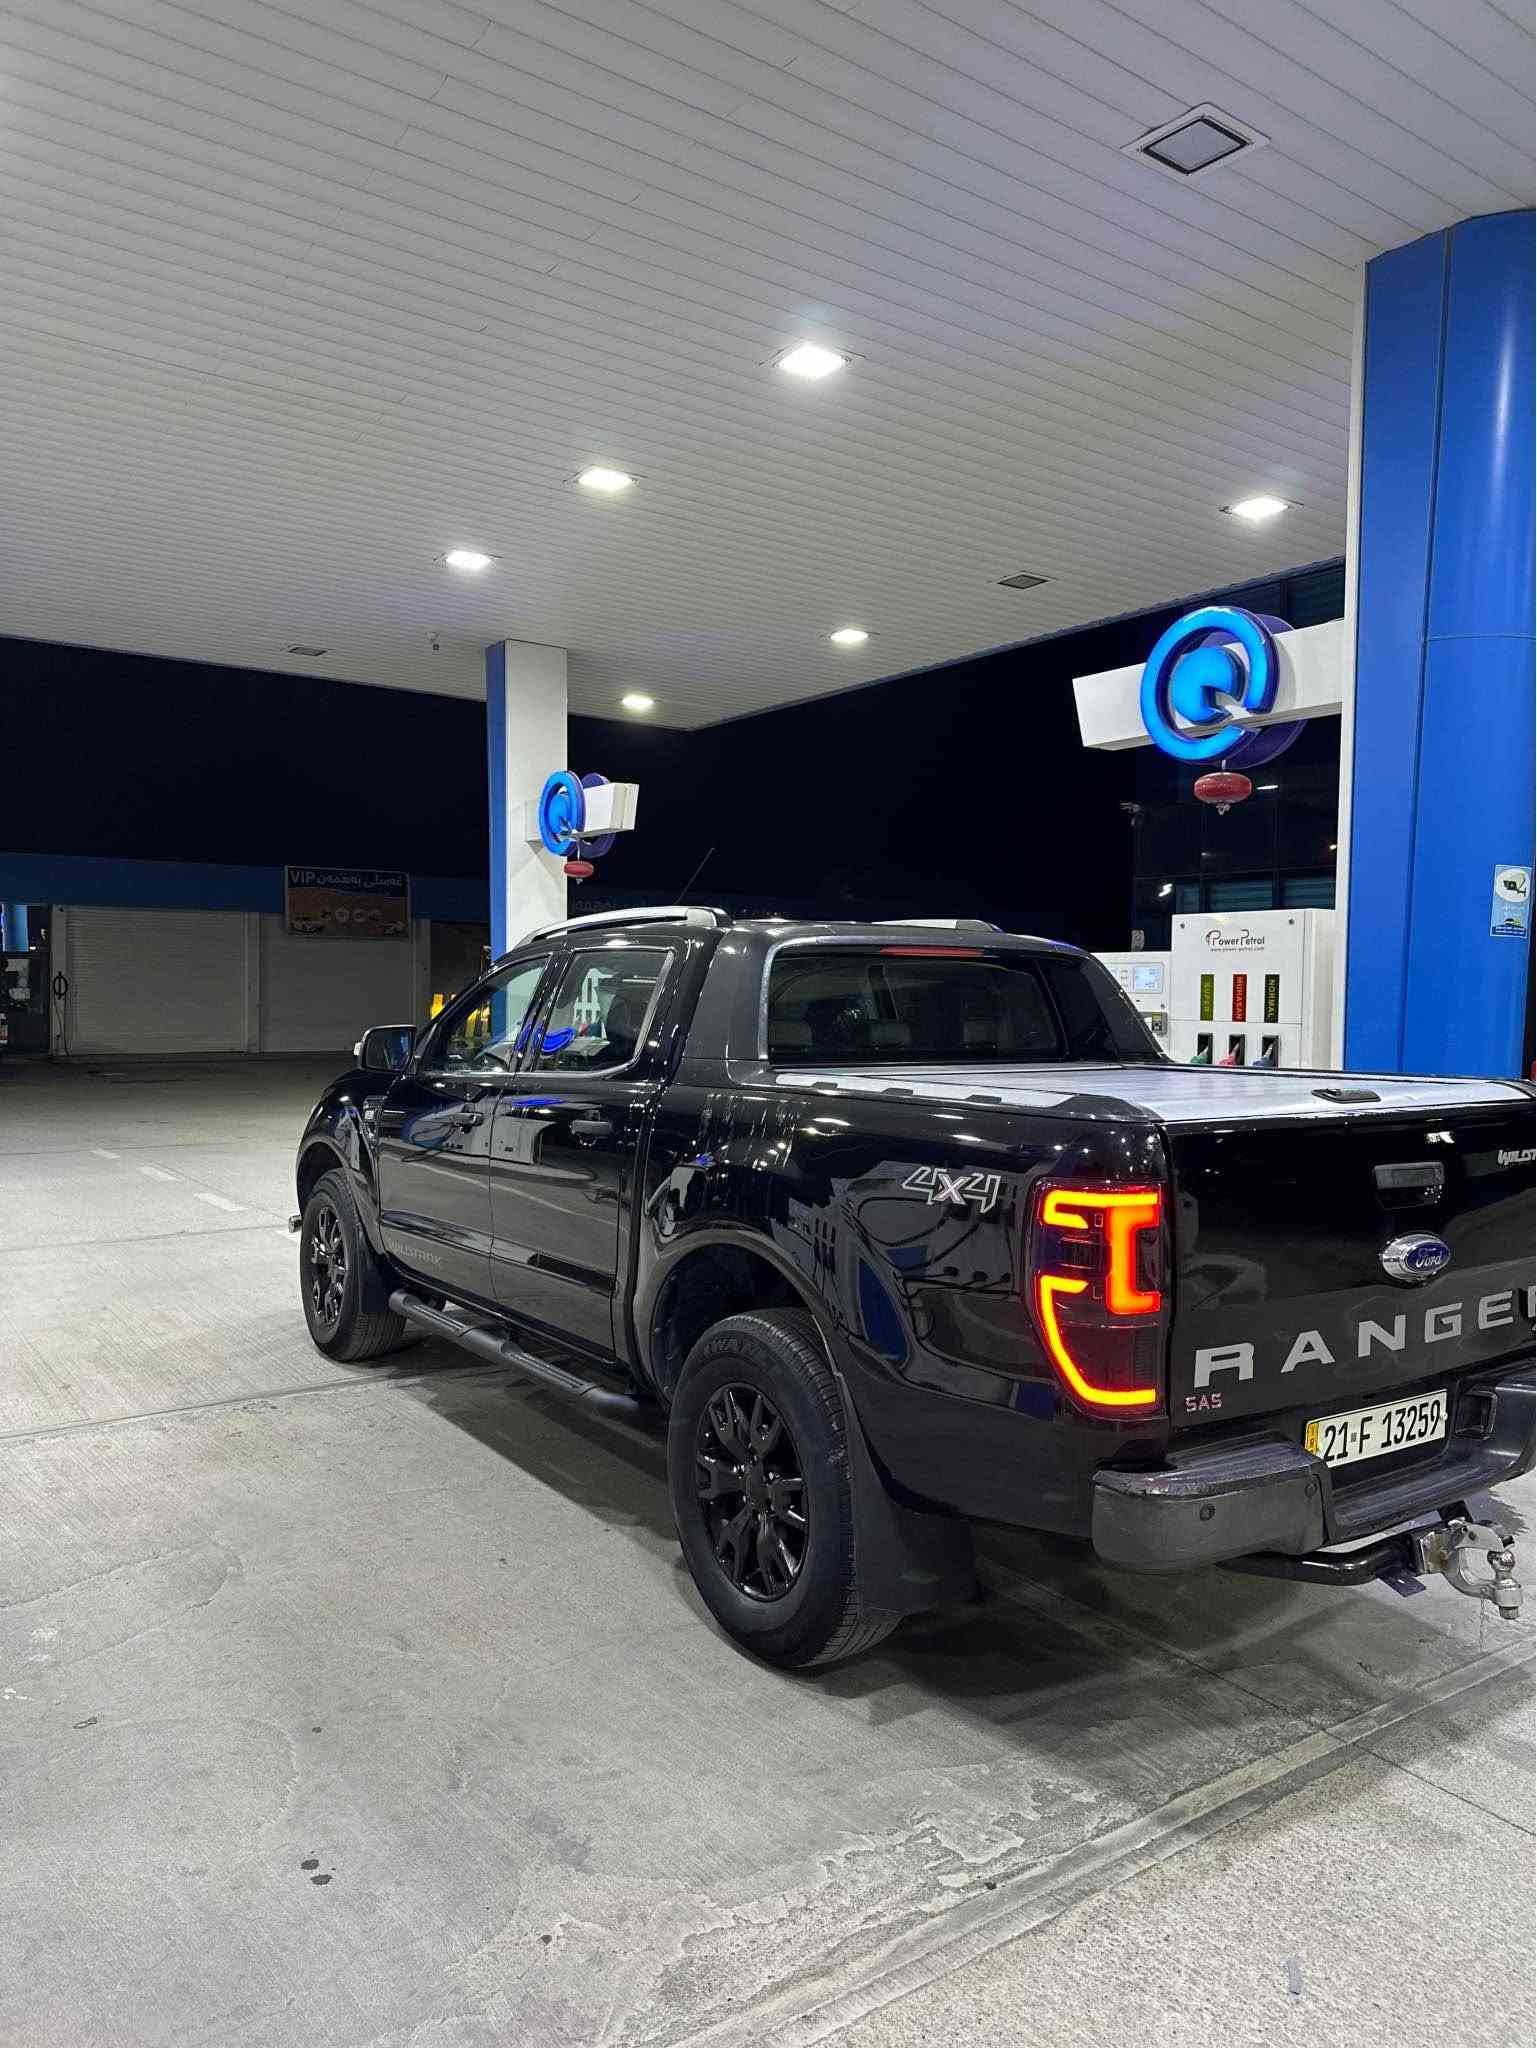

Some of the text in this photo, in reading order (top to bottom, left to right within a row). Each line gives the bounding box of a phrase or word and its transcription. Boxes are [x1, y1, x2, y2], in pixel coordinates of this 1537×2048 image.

[289, 871, 316, 884] VIP
[1268, 979, 1276, 1018] NORMAL
[1415, 1248, 1442, 1268] Ford
[1194, 1286, 1535, 1388] RANGE
[1186, 1392, 1222, 1412] SAS
[1381, 1400, 1441, 1448] 13259
